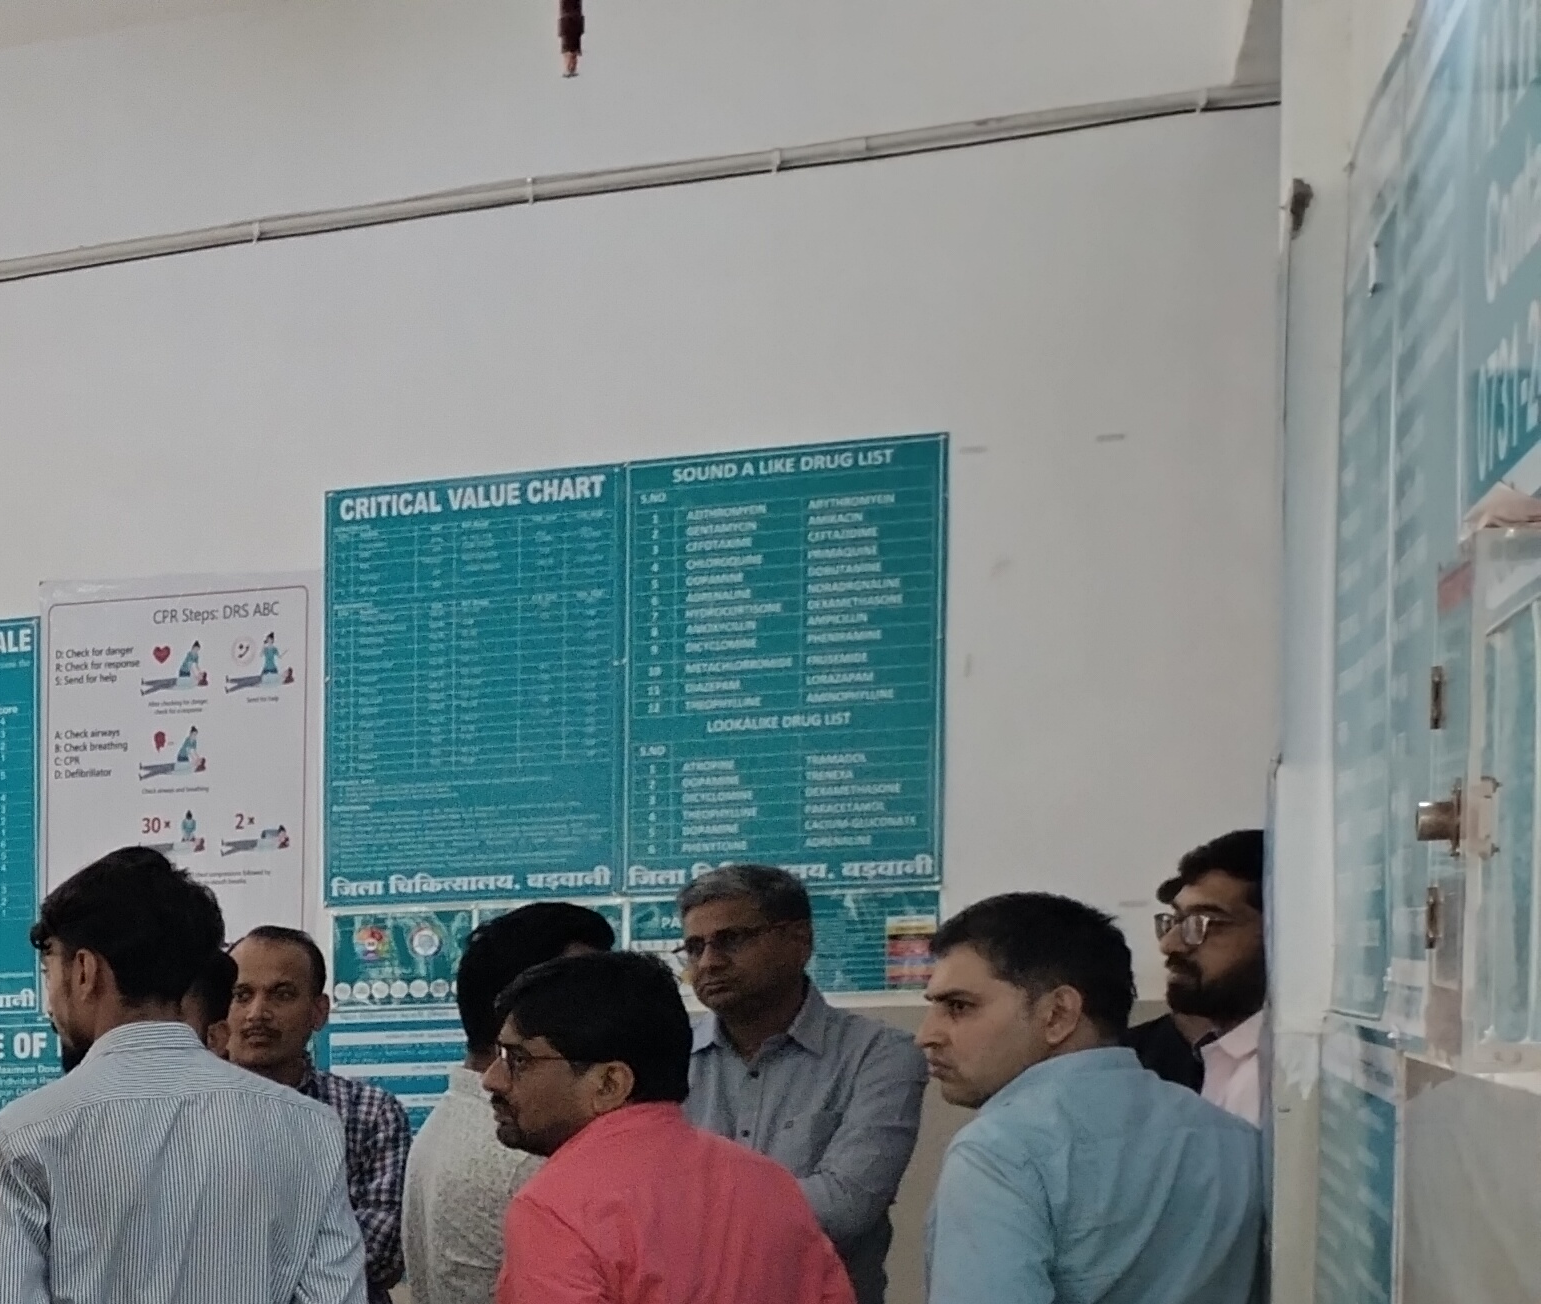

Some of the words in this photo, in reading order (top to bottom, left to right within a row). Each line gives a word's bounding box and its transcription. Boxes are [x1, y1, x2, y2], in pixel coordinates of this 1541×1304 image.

[672, 465, 737, 483] SOUND
[742, 462, 754, 475] A
[759, 457, 794, 474] LIKE
[800, 452, 853, 471] DRUG
[858, 449, 894, 465] LIST
[340, 491, 442, 520] CRITICAL
[448, 483, 521, 510] VALUE
[527, 475, 605, 504] CHART
[153, 609, 178, 624] CPR
[182, 608, 218, 624] Steps:
[222, 604, 249, 619] DRS
[252, 601, 279, 616] ABC
[55, 650, 64, 659] D:
[66, 648, 89, 658] Check
[91, 647, 103, 657] for
[105, 647, 134, 658] danger
[55, 663, 63, 672] R:
[65, 661, 89, 671] Check
[90, 660, 102, 670] for
[104, 659, 140, 669] response
[55, 677, 62, 686] S:
[64, 675, 84, 685] Send
[86, 674, 98, 683] for
[100, 673, 117, 684] help
[782, 713, 821, 729] DRUG
[825, 712, 851, 725] LIST
[54, 731, 63, 740] A:
[64, 729, 89, 739] Check
[90, 728, 120, 739] airways
[64, 742, 89, 751] Check
[90, 741, 128, 752] breathing
[54, 757, 62, 765] C:
[64, 756, 80, 765] CPR
[54, 770, 63, 779] D:
[65, 768, 112, 778] Defibrillator
[142, 817, 161, 834] 30
[235, 814, 245, 829] 2
[629, 865, 686, 885] जिला
[331, 877, 384, 897] जिला
[13, 1032, 47, 1059] OF
